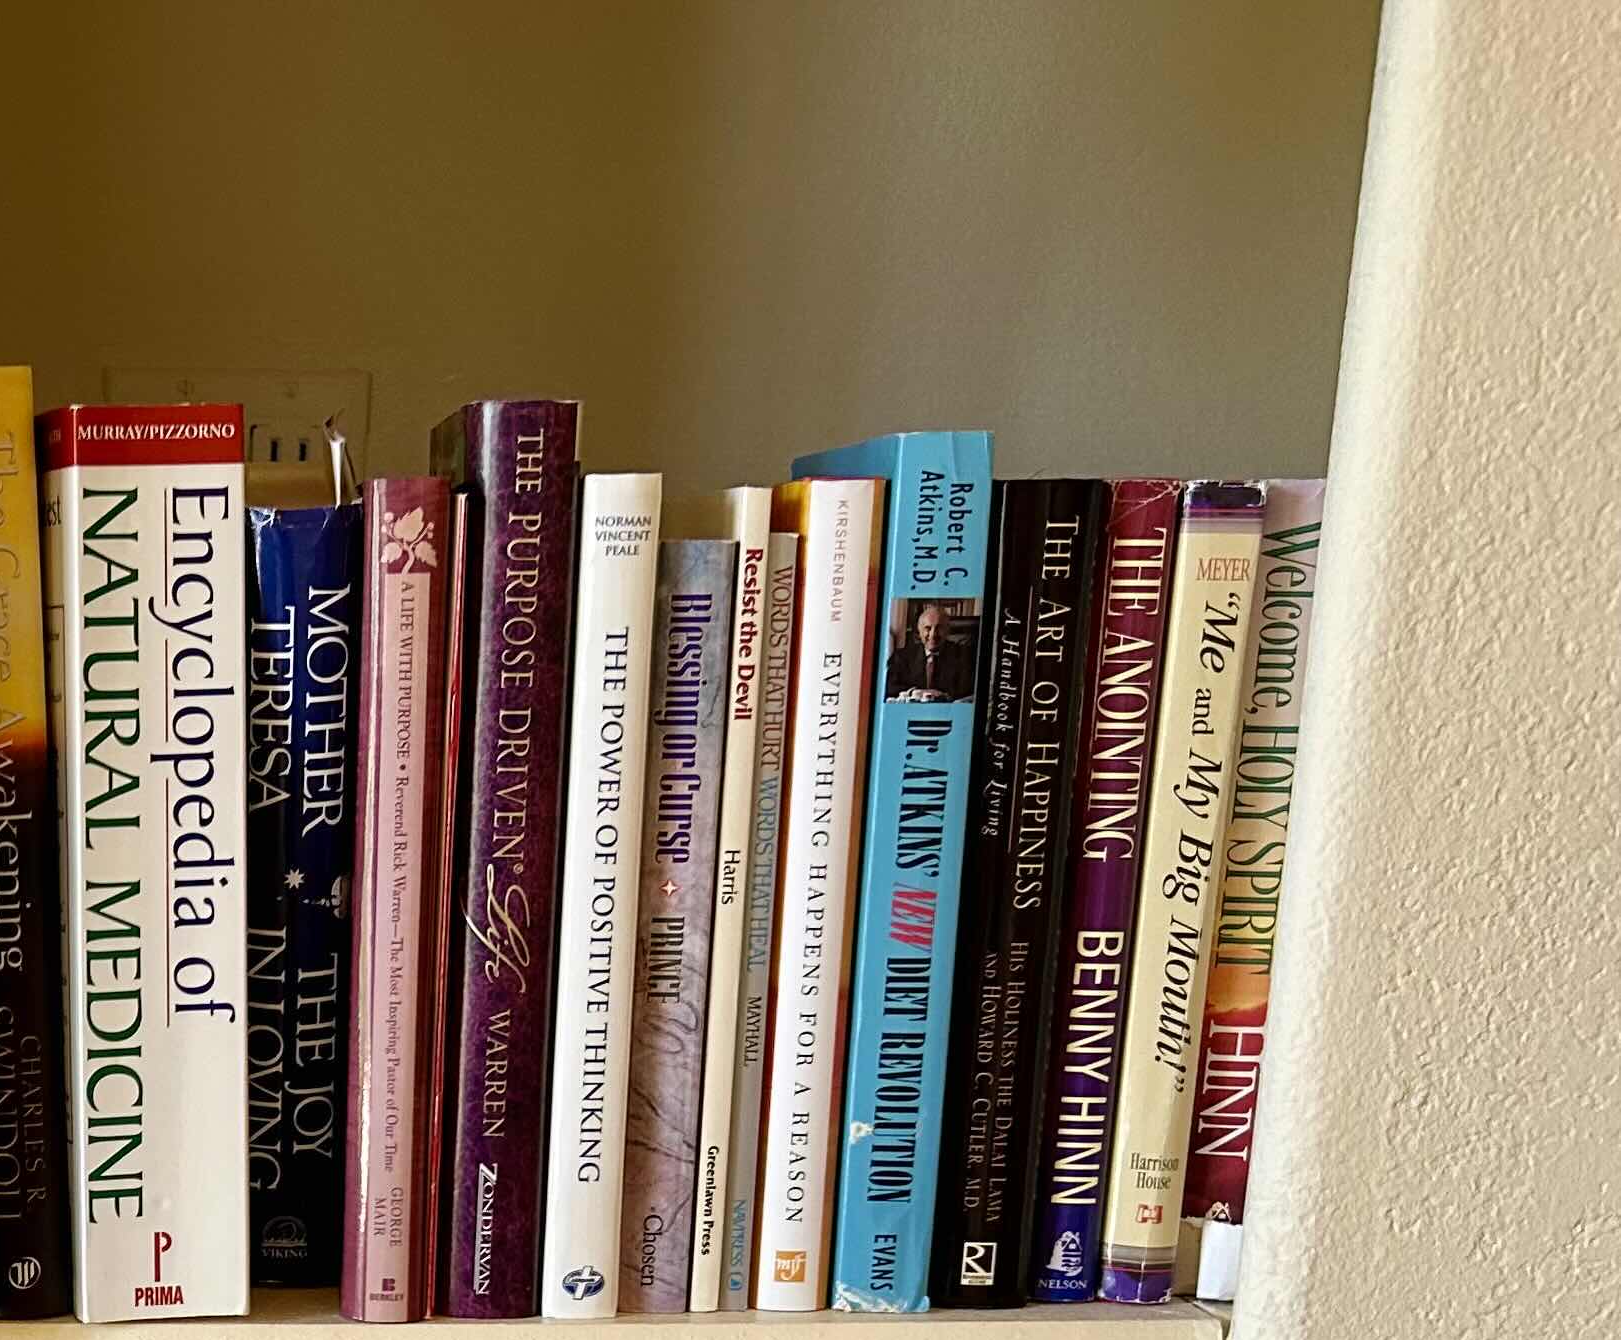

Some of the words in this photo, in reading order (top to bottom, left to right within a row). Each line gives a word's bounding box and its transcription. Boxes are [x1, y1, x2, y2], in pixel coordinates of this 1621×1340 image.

[77, 423, 236, 441] MURRAY/PIZZORNO
[595, 516, 651, 527] NORMAN
[595, 530, 651, 541] VINCENT
[605, 545, 640, 556] PEALE
[945, 482, 973, 555] Robert
[1042, 516, 1079, 580] THE
[741, 548, 763, 613] Resist
[943, 568, 968, 586] C.
[1107, 528, 1166, 616] THE
[1196, 558, 1251, 582] MEYER
[603, 626, 630, 691] THE
[738, 616, 759, 658] the
[1035, 599, 1071, 662] ART
[82, 487, 143, 849] NATURAL
[734, 665, 755, 720] Devil
[149, 486, 236, 929] Encyclopedia
[1030, 681, 1060, 723] OF
[596, 705, 625, 815] POWER
[810, 652, 842, 847] EVERYTHING
[1083, 630, 1154, 862] ANOINTING
[594, 823, 618, 865] OF
[1014, 742, 1059, 909] HAPPINESS
[587, 878, 616, 1015] POSITIVE
[799, 863, 828, 996] HAPPENS
[890, 883, 938, 952] NEW
[172, 958, 236, 1023] of
[883, 957, 932, 1021] DIET
[1064, 930, 1124, 1083] BENNY
[85, 880, 145, 1224] MEDICINE
[794, 1013, 817, 1065] FOR
[578, 1022, 609, 1184] THINKING
[794, 1084, 811, 1096] A
[868, 1031, 926, 1203] REVOLUTION
[702, 1146, 720, 1216] Greenlawn
[785, 1112, 810, 1223] REASON
[1052, 1096, 1107, 1205] HINN
[1130, 1152, 1178, 1171] Harrison
[1136, 1173, 1171, 1190] House
[641, 1214, 663, 1288] Chosen
[701, 1221, 716, 1256] Press
[870, 1233, 897, 1291] EVANS
[134, 1286, 184, 1307] PRIMA
[1038, 1279, 1088, 1289] NELSON
